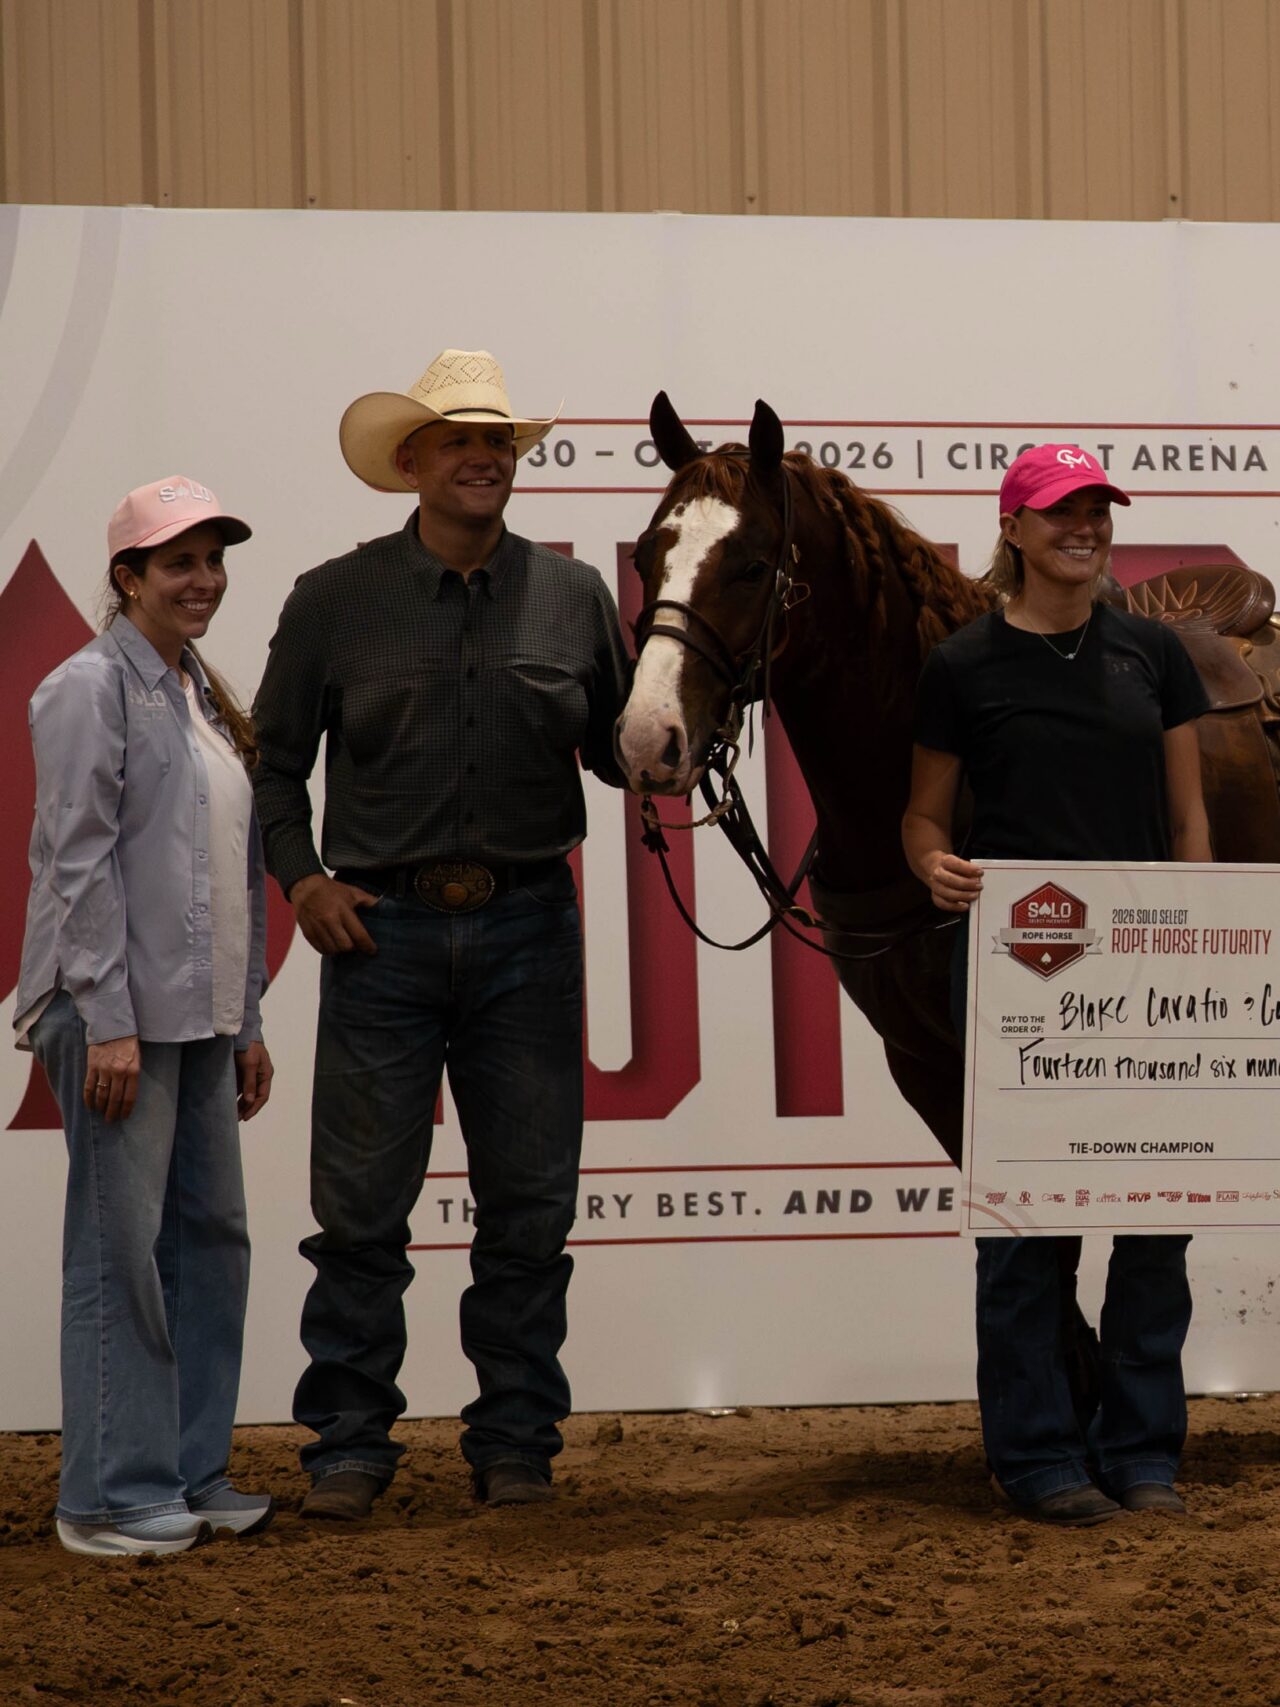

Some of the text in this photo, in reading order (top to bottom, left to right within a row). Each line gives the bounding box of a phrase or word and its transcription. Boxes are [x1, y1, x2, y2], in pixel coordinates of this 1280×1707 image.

[1132, 444, 1268, 472] ARENA
[1112, 908, 1188, 925] 2026 SOLO SELECT
[1022, 931, 1073, 941] ROPE HORSE
[1111, 928, 1272, 955] ROPE HORSE FUTURITY
[1001, 1015, 1046, 1024] PAY TO THE
[1001, 1025, 1045, 1034] ORDER OF:
[1018, 1037, 1106, 1085] Fourteen
[1114, 1053, 1200, 1081] thousand
[1209, 1056, 1237, 1079] six
[1069, 1141, 1214, 1155] TIE-DOWN CHAMPION
[656, 1191, 763, 1219] BEST.
[783, 1188, 873, 1215] AND
[1127, 1192, 1151, 1203] MVP
